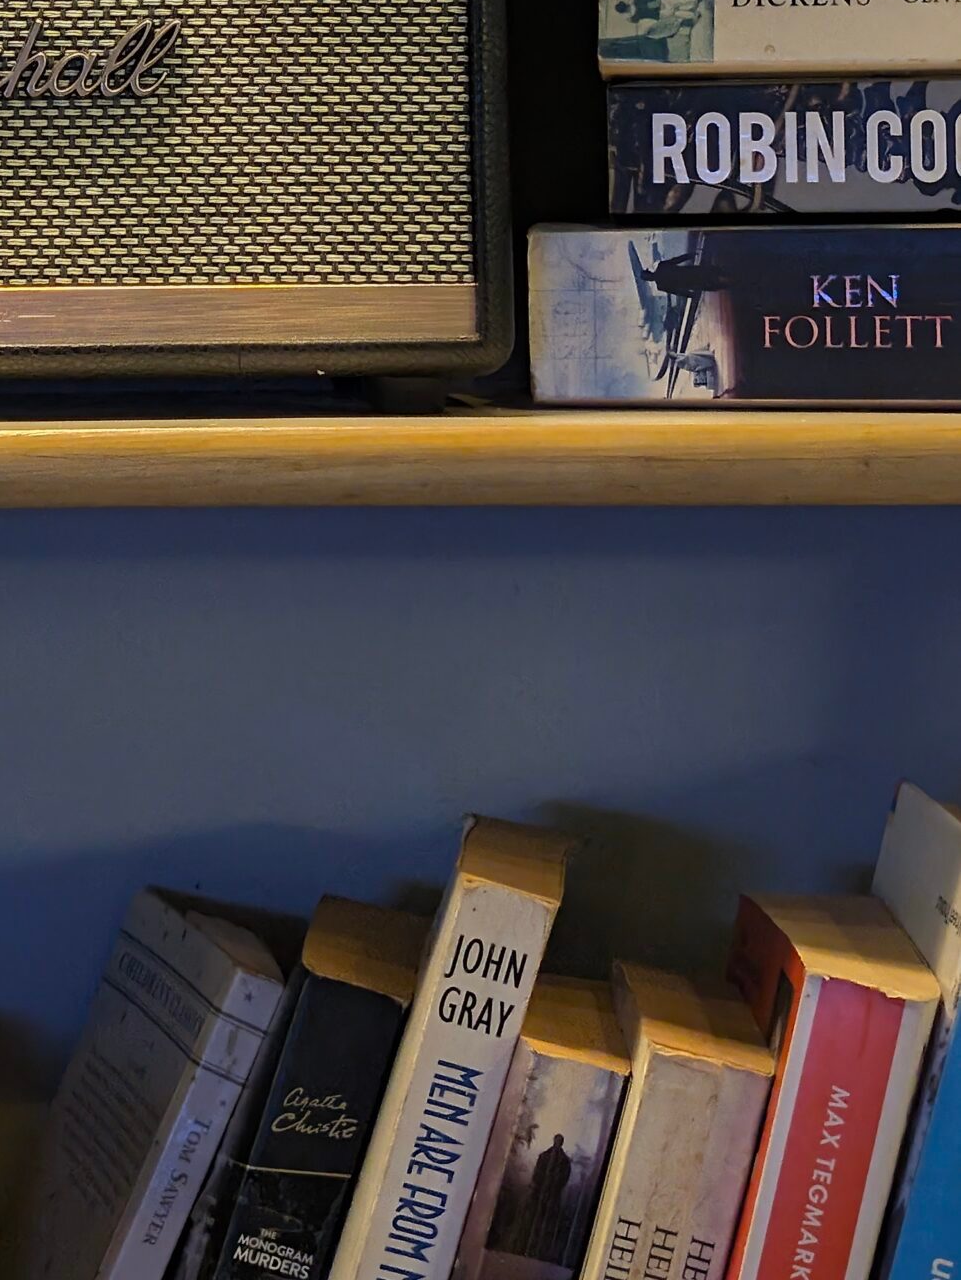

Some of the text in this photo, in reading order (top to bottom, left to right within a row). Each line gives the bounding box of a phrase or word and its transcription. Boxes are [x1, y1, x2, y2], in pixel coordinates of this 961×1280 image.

[651, 108, 961, 184] ROBIN CO
[810, 274, 900, 309] KEN
[763, 315, 953, 349] FOLLETT
[444, 934, 529, 989] JOHN
[437, 986, 516, 1038] GRAY
[283, 1087, 347, 1114] Agatha
[423, 1058, 486, 1127] MEN
[271, 1110, 359, 1139] Christie
[406, 1122, 466, 1184] ARE
[141, 1116, 213, 1247] TOM SAWYER
[788, 1084, 852, 1280] MAX TEGMARK
[260, 1227, 278, 1241] THE
[384, 1182, 448, 1264] FROM
[233, 1245, 311, 1280] MURDERS
[237, 1233, 315, 1267] MONOGRAM
